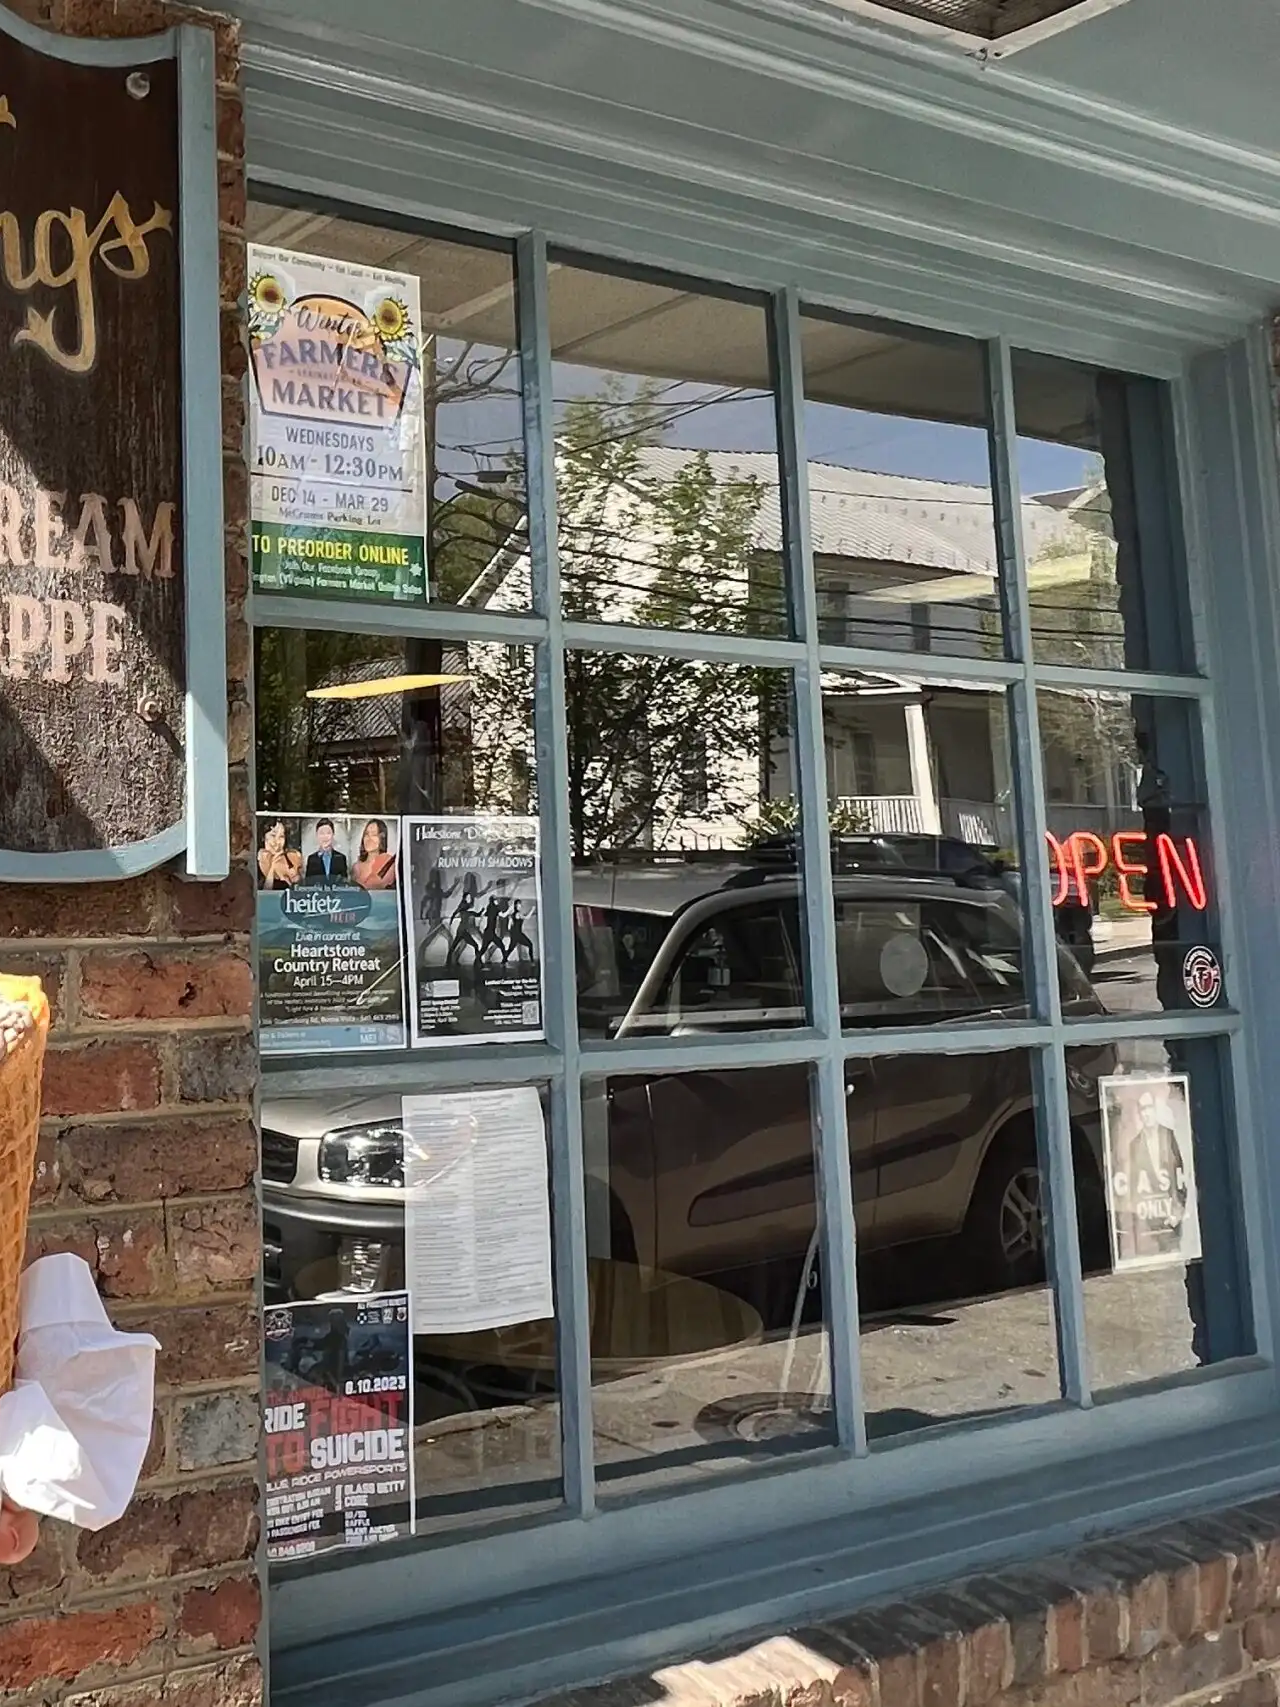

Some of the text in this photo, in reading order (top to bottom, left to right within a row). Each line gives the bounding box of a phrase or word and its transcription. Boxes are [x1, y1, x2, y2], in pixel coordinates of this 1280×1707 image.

[294, 305, 363, 338] Winter
[272, 378, 386, 418] MARKET
[285, 427, 375, 451] WEDNESDAYS
[256, 445, 305, 470] 10AM
[324, 453, 403, 481] 12:30PM
[271, 485, 296, 503] DEC
[302, 489, 316, 505] 14
[335, 492, 365, 510] MAR
[371, 497, 389, 512] 29
[327, 511, 363, 526] Parking
[252, 534, 410, 566] TO PREORDER ONLINE
[438, 856, 534, 868] RUN WITH SHADOWS
[285, 888, 341, 913] heifetz
[291, 943, 366, 958] Heartstone
[274, 957, 381, 974] Country Retreat
[293, 974, 317, 988] April
[1113, 1167, 1189, 1195] CASH
[1136, 1197, 1174, 1220] ONLY
[264, 1402, 305, 1433] RIDE
[309, 1392, 404, 1440] FIGHT
[266, 1428, 405, 1480] TO SUICIDE
[291, 1473, 321, 1488] RIDGE
[324, 1462, 408, 1480] POWERSPORTS
